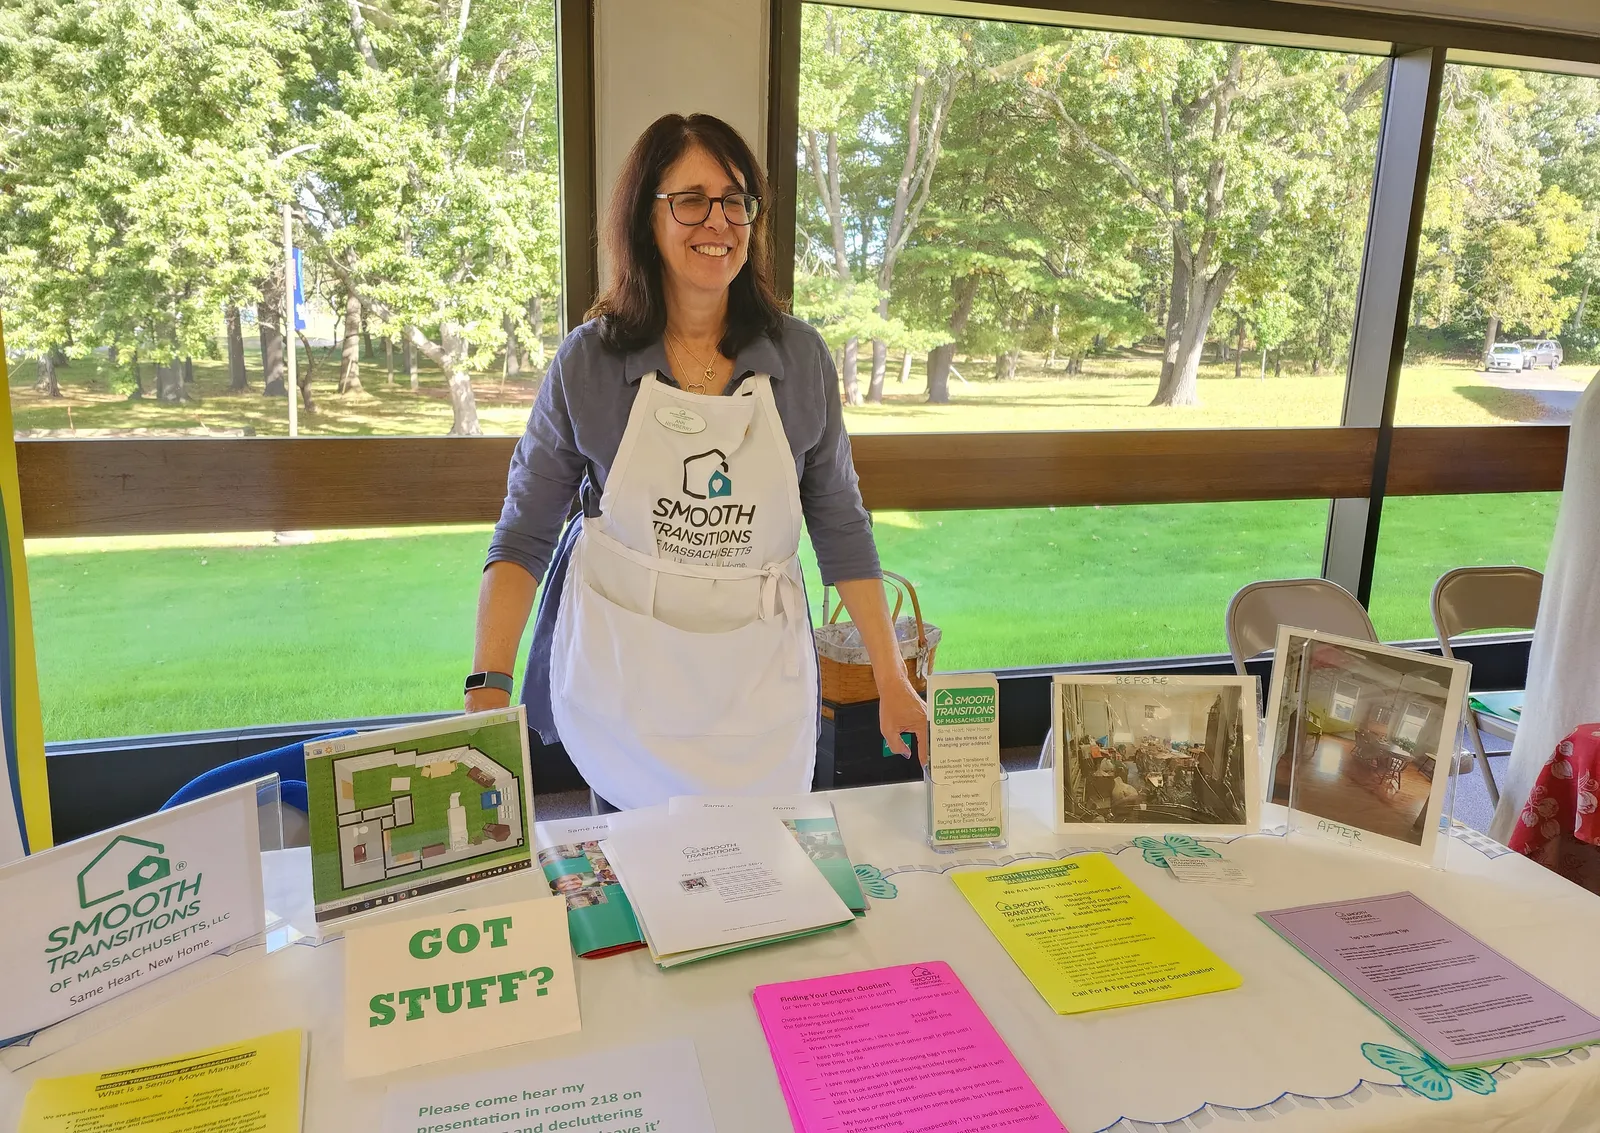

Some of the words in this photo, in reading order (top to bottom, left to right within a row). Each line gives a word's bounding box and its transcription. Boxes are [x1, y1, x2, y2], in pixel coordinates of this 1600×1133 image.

[652, 498, 756, 528] SMOOTH
[652, 520, 752, 546] TRANSITIONS
[1115, 676, 1168, 686] BEFORE
[954, 696, 994, 704] SMOOTH
[936, 706, 994, 716] TRANSITIONS
[1316, 820, 1362, 841] AFTER
[686, 847, 740, 859] TRANSITIONS
[701, 842, 737, 851] SMOOTH
[1019, 866, 1067, 878] TRANSITIONS
[1073, 888, 1110, 898] Decluttering
[1097, 894, 1131, 903] Organizing
[1013, 900, 1045, 909] SMOOTH
[1092, 899, 1129, 909] Downsizing
[44, 872, 202, 954] SMOOTH
[1066, 921, 1106, 931] Management
[48, 900, 202, 974] TRANSITIONS
[408, 916, 512, 960] GOT
[50, 978, 72, 994] OF
[78, 921, 210, 982] MASSACHUSETTS,
[212, 912, 231, 925] LLC
[70, 985, 104, 1006] Same
[108, 967, 144, 990] Heart.
[148, 954, 174, 972] New
[177, 940, 213, 958] Home.
[1072, 988, 1087, 997] Call
[1111, 982, 1129, 991] Free
[1147, 976, 1167, 985] Hour
[1167, 966, 1215, 981] Consultation
[369, 966, 554, 1028] STUFF?
[780, 994, 809, 1003] Finding
[830, 987, 856, 996] Clutter
[857, 980, 890, 991] Quotient
[880, 1058, 899, 1067] plastic
[900, 1054, 926, 1062] shopping
[844, 1074, 875, 1084] magazines
[890, 1065, 922, 1075] interesting
[923, 1057, 967, 1069] articles/recipes.
[97, 1088, 124, 1099] What
[127, 1085, 133, 1093] is
[145, 1076, 176, 1089] Senior
[178, 1070, 205, 1082] Move
[193, 1088, 223, 1097] Memories
[856, 1091, 884, 1101] Unclutter
[897, 1096, 912, 1104] craft
[912, 1091, 937, 1102] projects
[937, 1088, 954, 1096] going
[418, 1102, 470, 1117] Please
[475, 1094, 518, 1108] come
[522, 1088, 557, 1100] hear
[562, 1084, 585, 1094] my
[950, 1096, 973, 1105] people,
[75, 1114, 105, 1123] Emotions
[417, 1111, 520, 1133] presentation
[525, 1108, 539, 1117] in
[544, 1100, 586, 1114] room
[591, 1093, 618, 1106] 218
[623, 1091, 642, 1100] on
[74, 1120, 100, 1129] Feelings
[514, 1123, 543, 1133] and
[548, 1108, 643, 1132] decluttering
